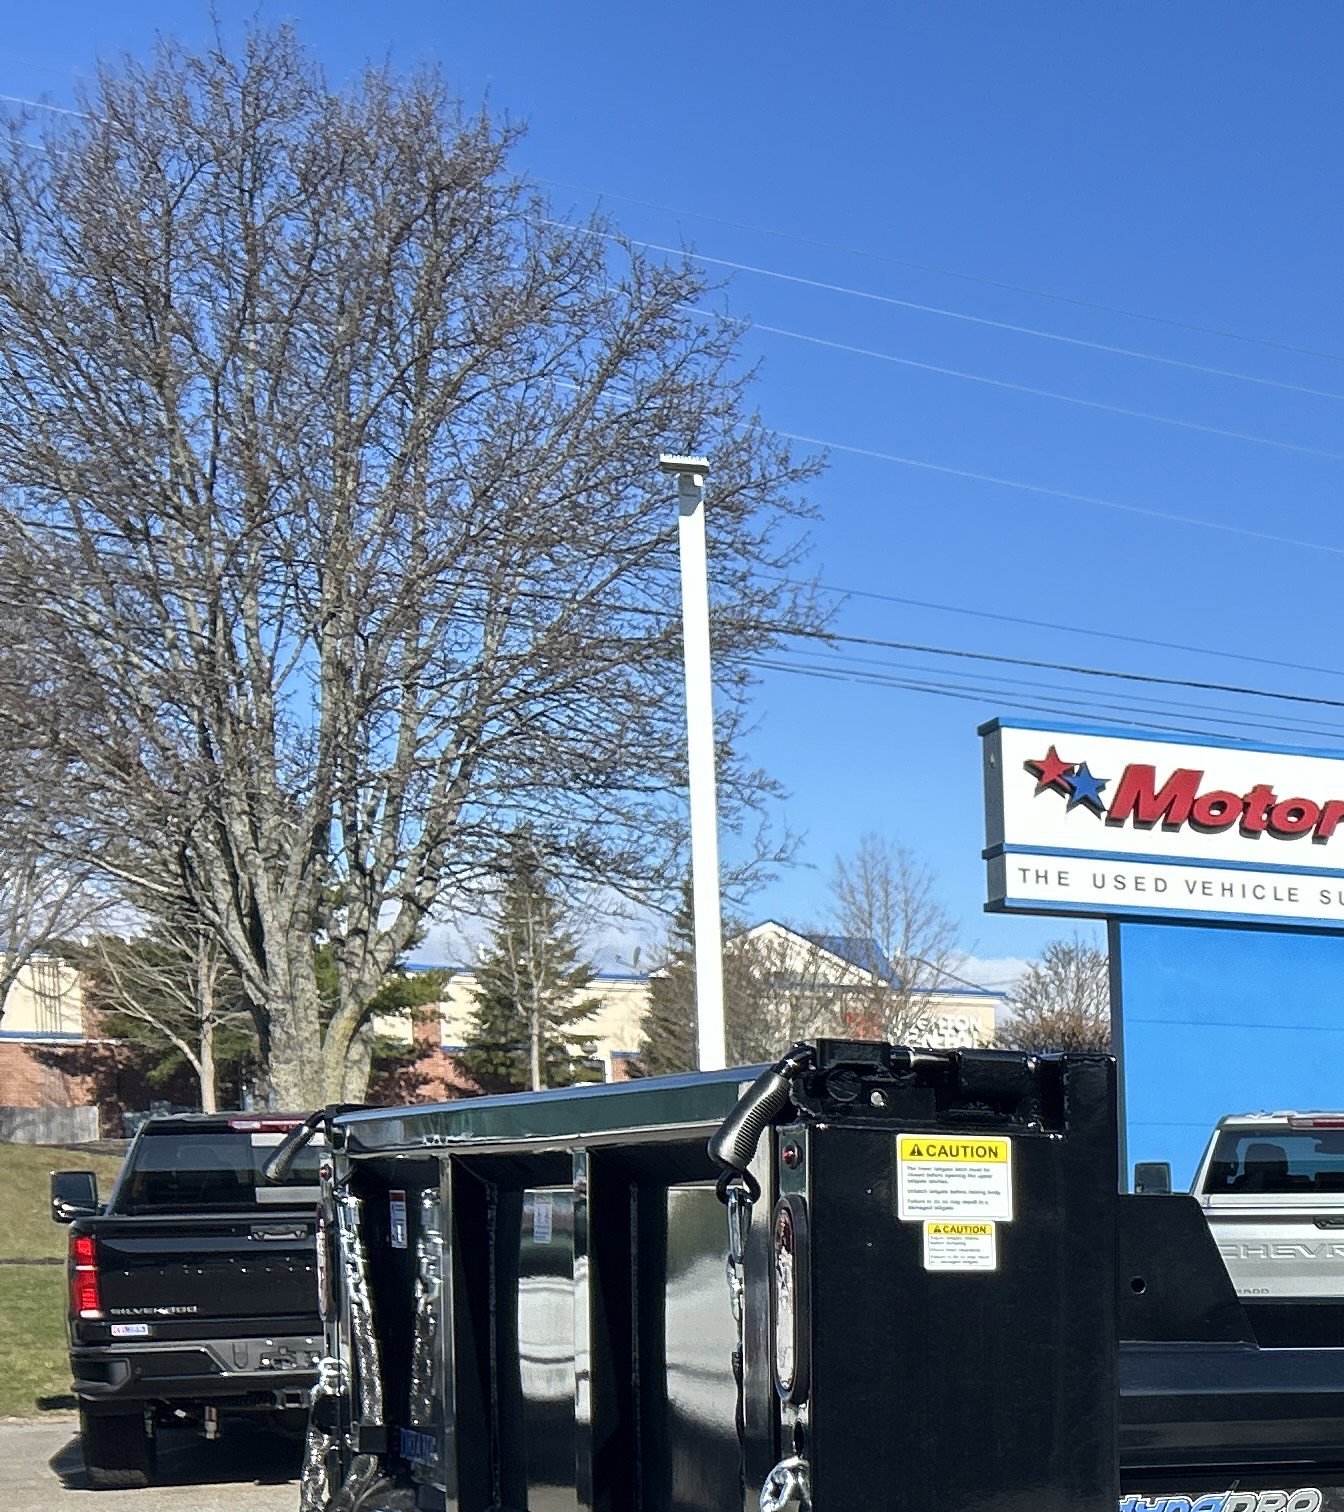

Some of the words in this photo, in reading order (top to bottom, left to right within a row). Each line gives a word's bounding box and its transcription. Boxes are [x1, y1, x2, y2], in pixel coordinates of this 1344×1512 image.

[1018, 867, 1071, 888] THE
[1092, 873, 1169, 894] USED
[1185, 880, 1300, 903] VEHICLE
[926, 1144, 999, 1159] CAUTION
[943, 1225, 987, 1234] CAUTION
